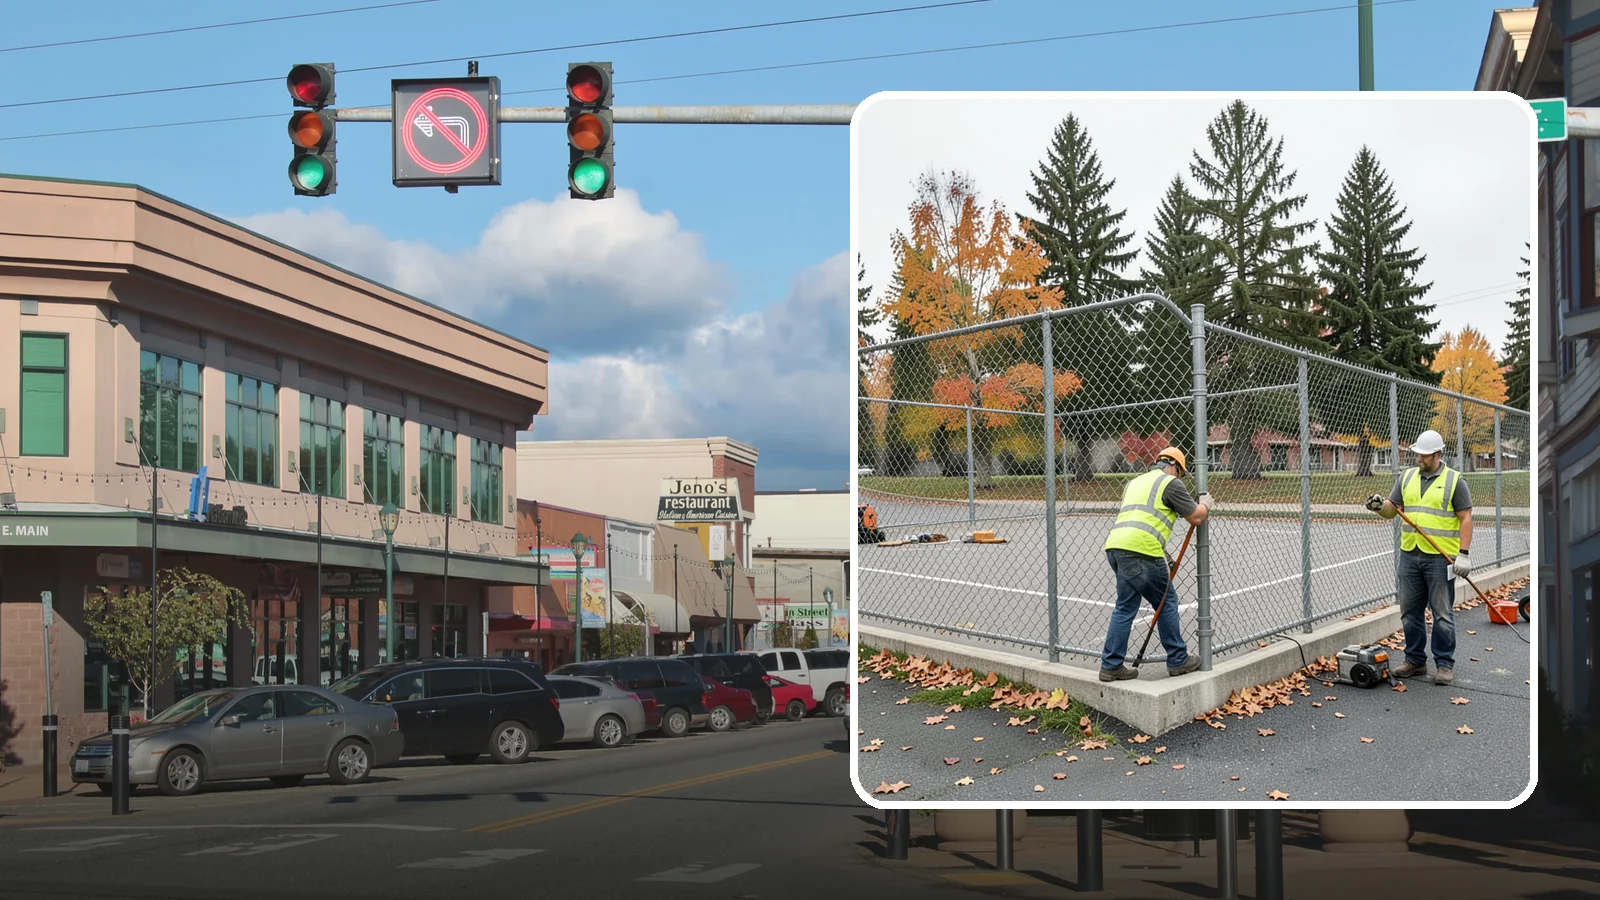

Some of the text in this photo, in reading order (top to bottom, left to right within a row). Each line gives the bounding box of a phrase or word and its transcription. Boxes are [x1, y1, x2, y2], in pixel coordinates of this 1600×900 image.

[670, 480, 727, 494] Jeno's
[665, 497, 731, 508] restaurant
[659, 510, 681, 519] Italian
[686, 510, 714, 519] American
[715, 510, 737, 519] Cuisine
[2, 525, 49, 536] E. MAIN
[797, 607, 828, 617] Street
